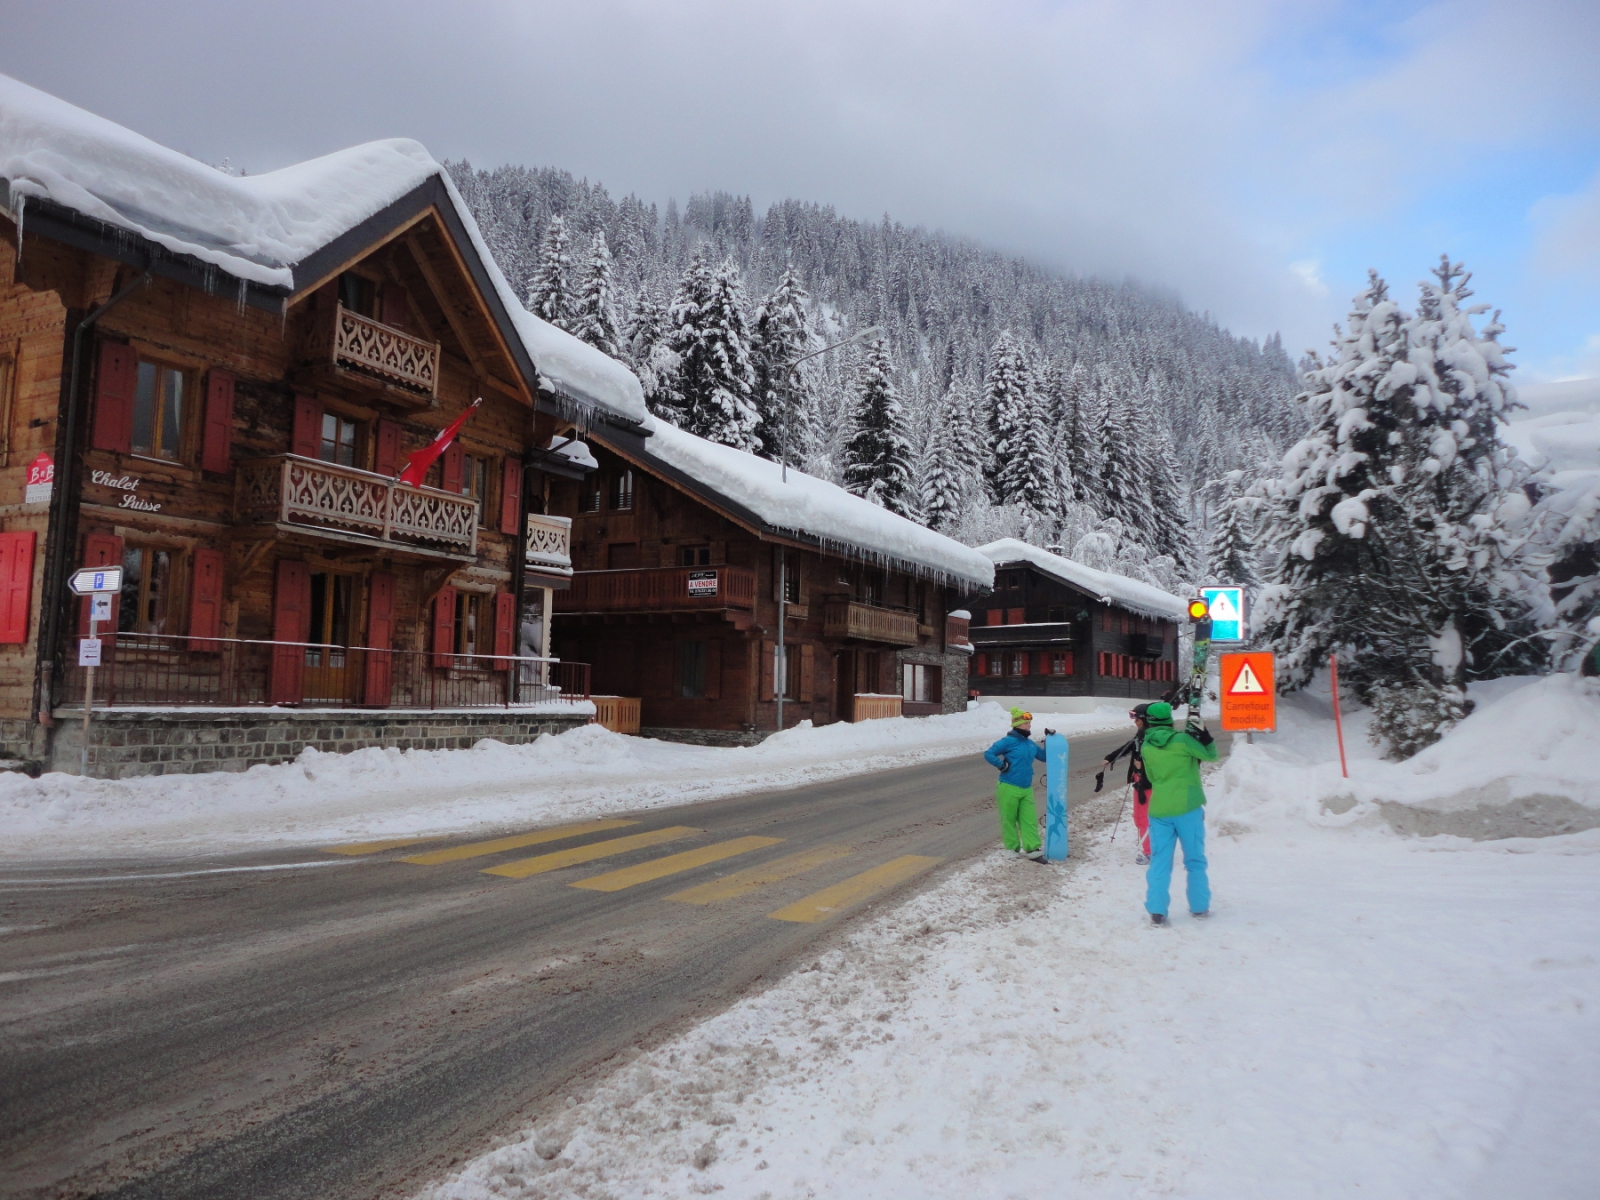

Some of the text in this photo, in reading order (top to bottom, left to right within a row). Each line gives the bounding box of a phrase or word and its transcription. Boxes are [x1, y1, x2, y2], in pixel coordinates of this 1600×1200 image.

[91, 470, 139, 491] Chalet
[118, 494, 161, 512] Suisse
[1226, 701, 1270, 711] Carrefour
[1230, 714, 1266, 724] modifié
